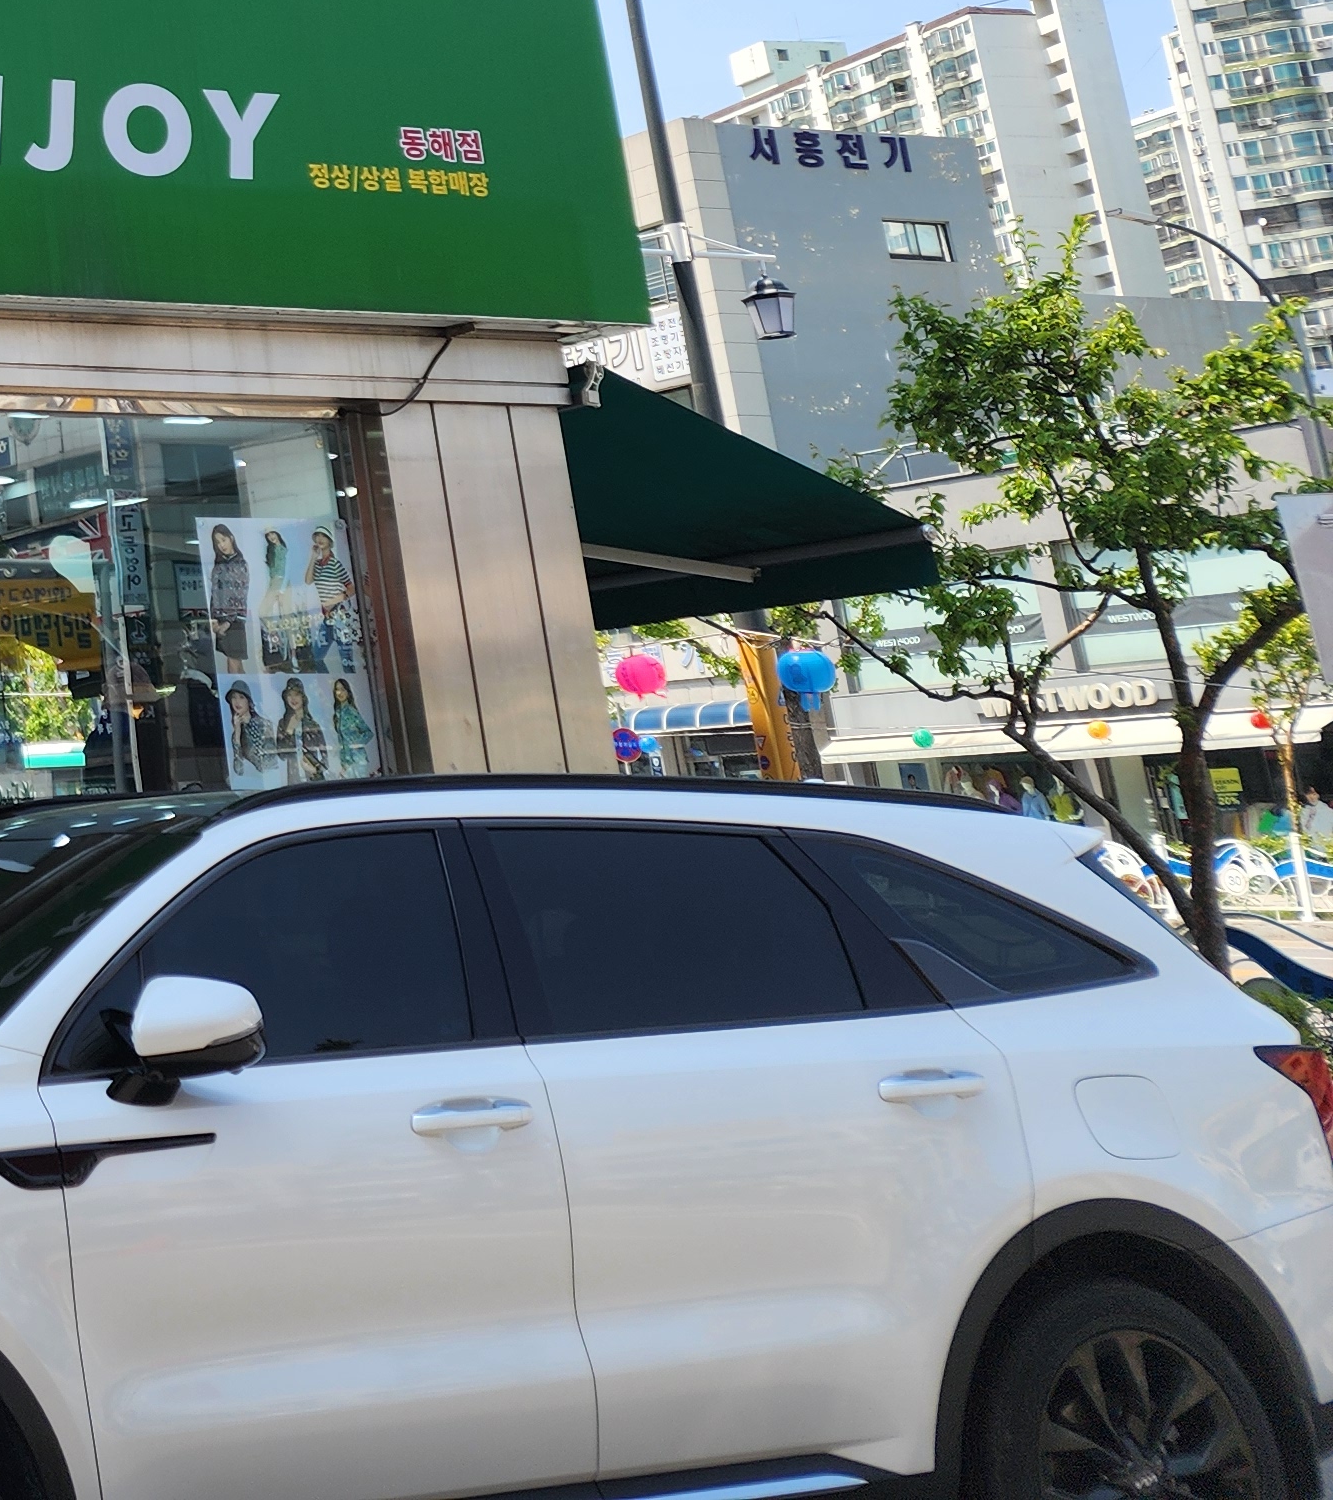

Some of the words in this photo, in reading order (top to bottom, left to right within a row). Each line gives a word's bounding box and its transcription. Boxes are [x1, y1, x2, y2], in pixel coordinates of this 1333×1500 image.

[399, 126, 485, 164] 동해점
[748, 127, 913, 172] 서흥전기
[407, 167, 489, 197] 복합매장
[1107, 611, 1156, 624] WESTWOO
[979, 678, 1160, 718] WTWOOD
